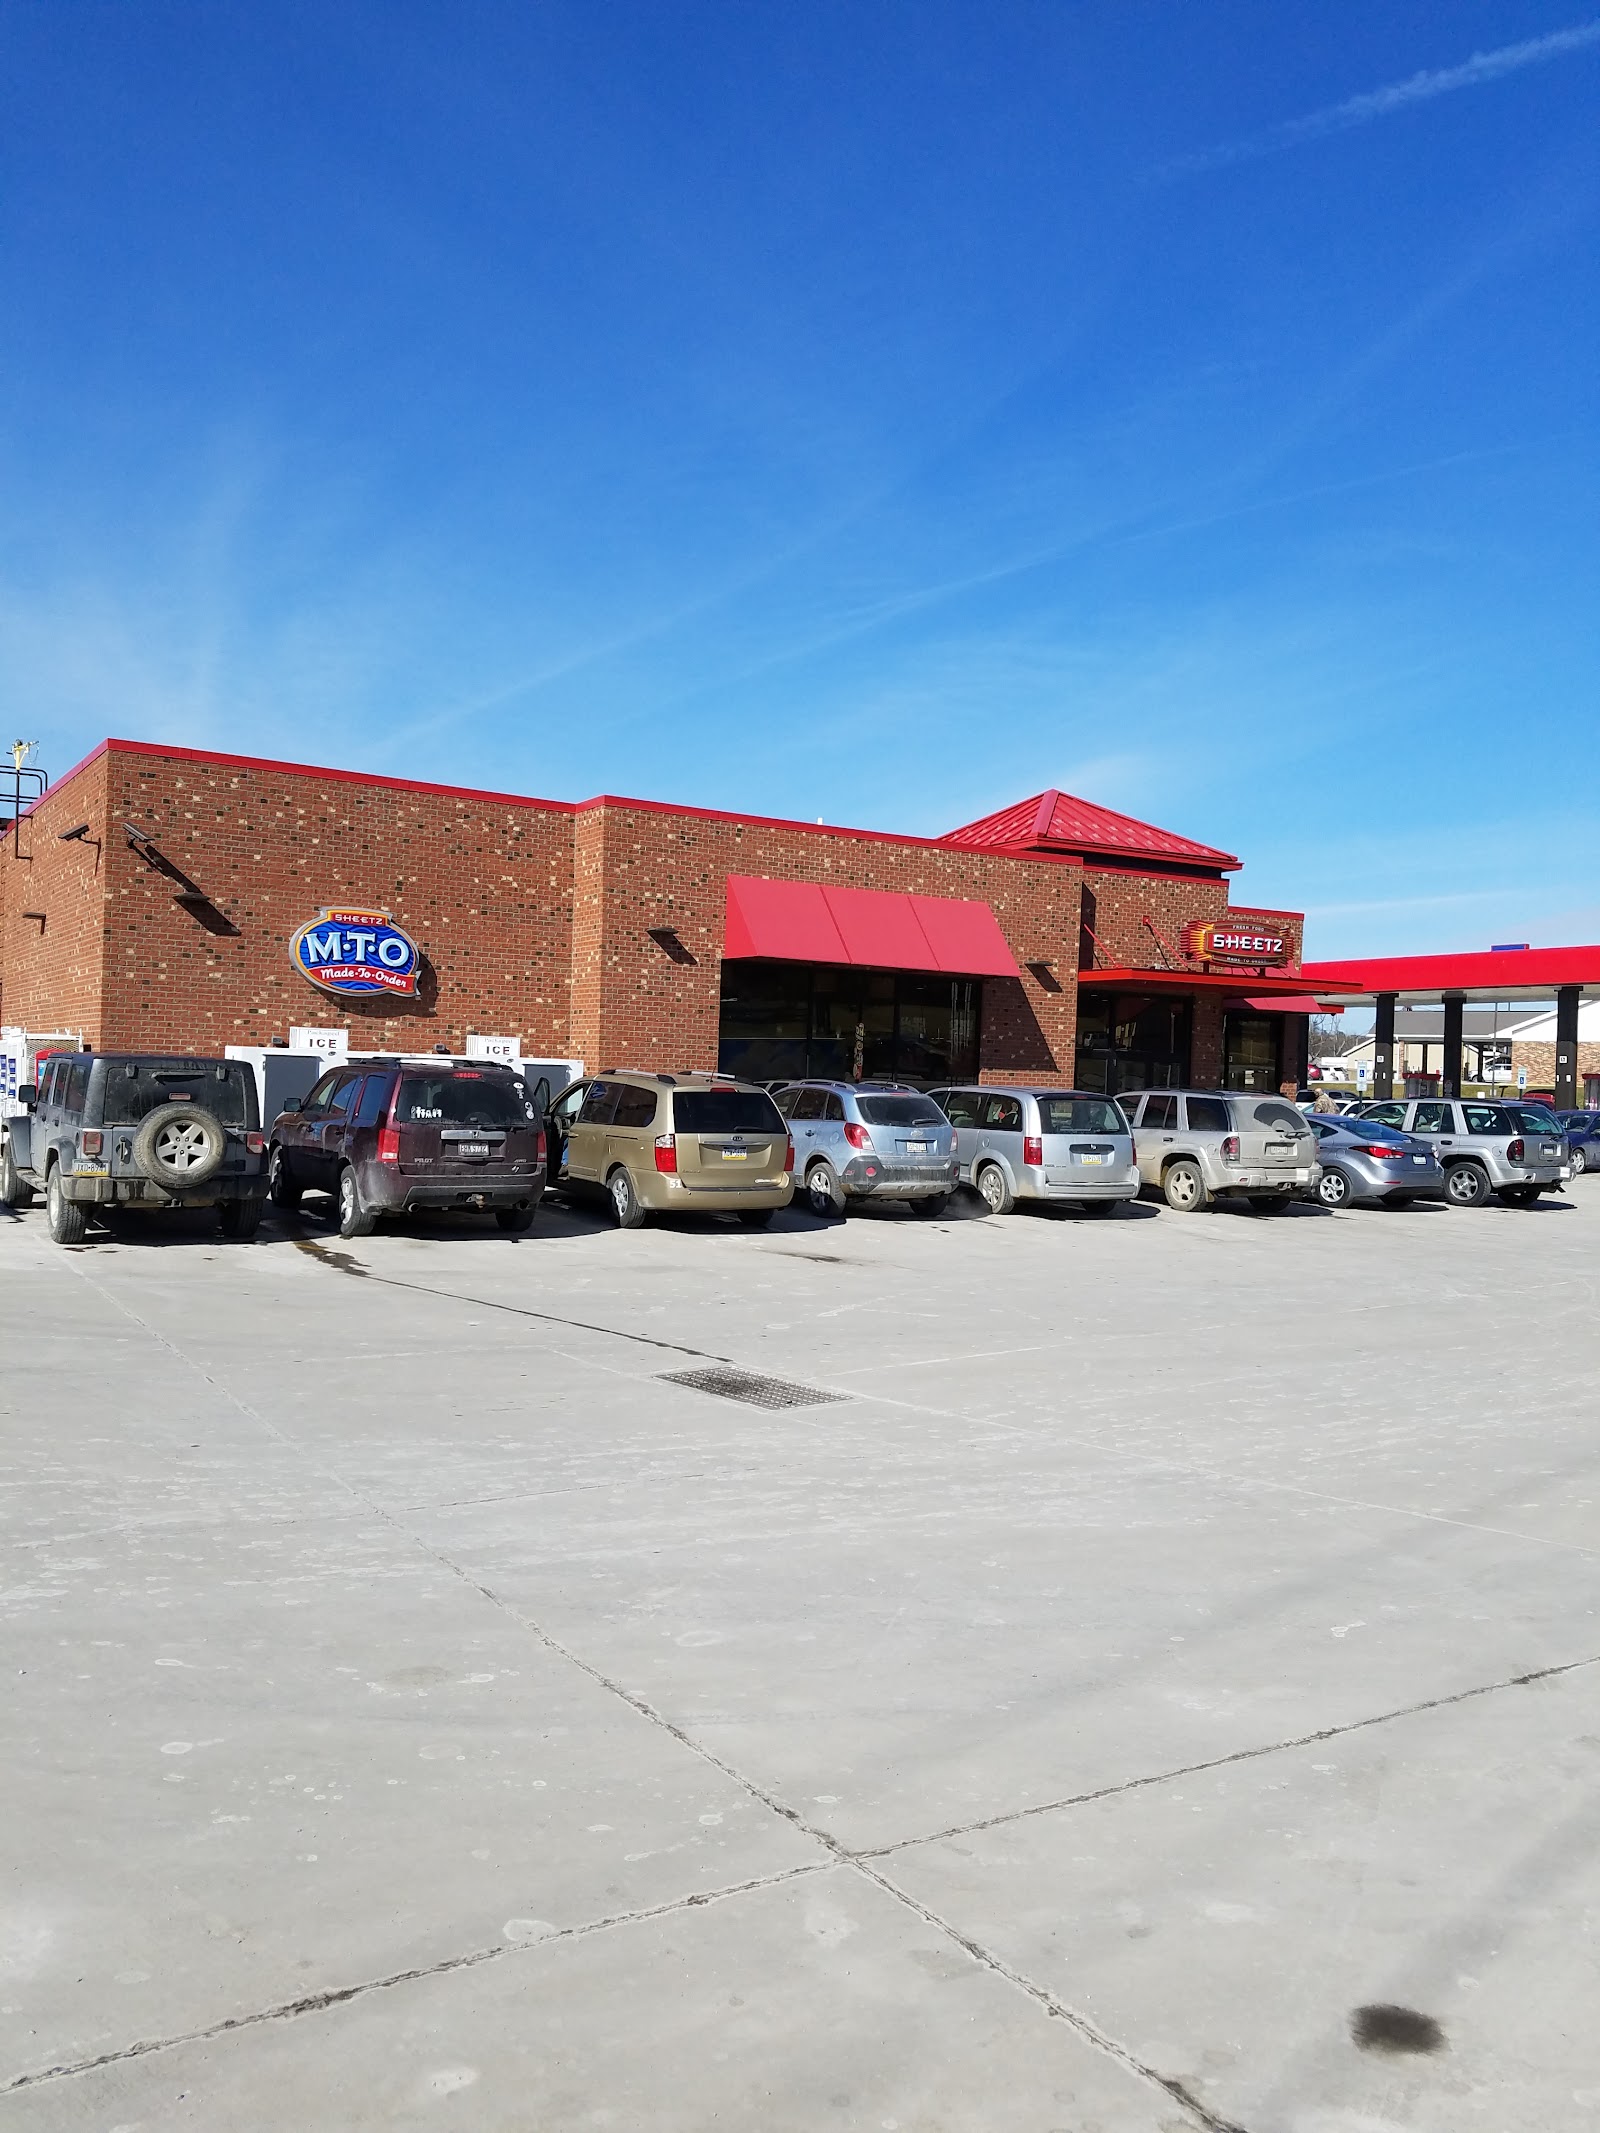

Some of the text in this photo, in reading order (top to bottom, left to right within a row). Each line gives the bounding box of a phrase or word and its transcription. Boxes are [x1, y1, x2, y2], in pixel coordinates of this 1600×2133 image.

[335, 914, 383, 925] SHEETZ
[1213, 934, 1283, 952] SHEETZ
[309, 1038, 337, 1049] ICE
[486, 1045, 510, 1056] ICE
